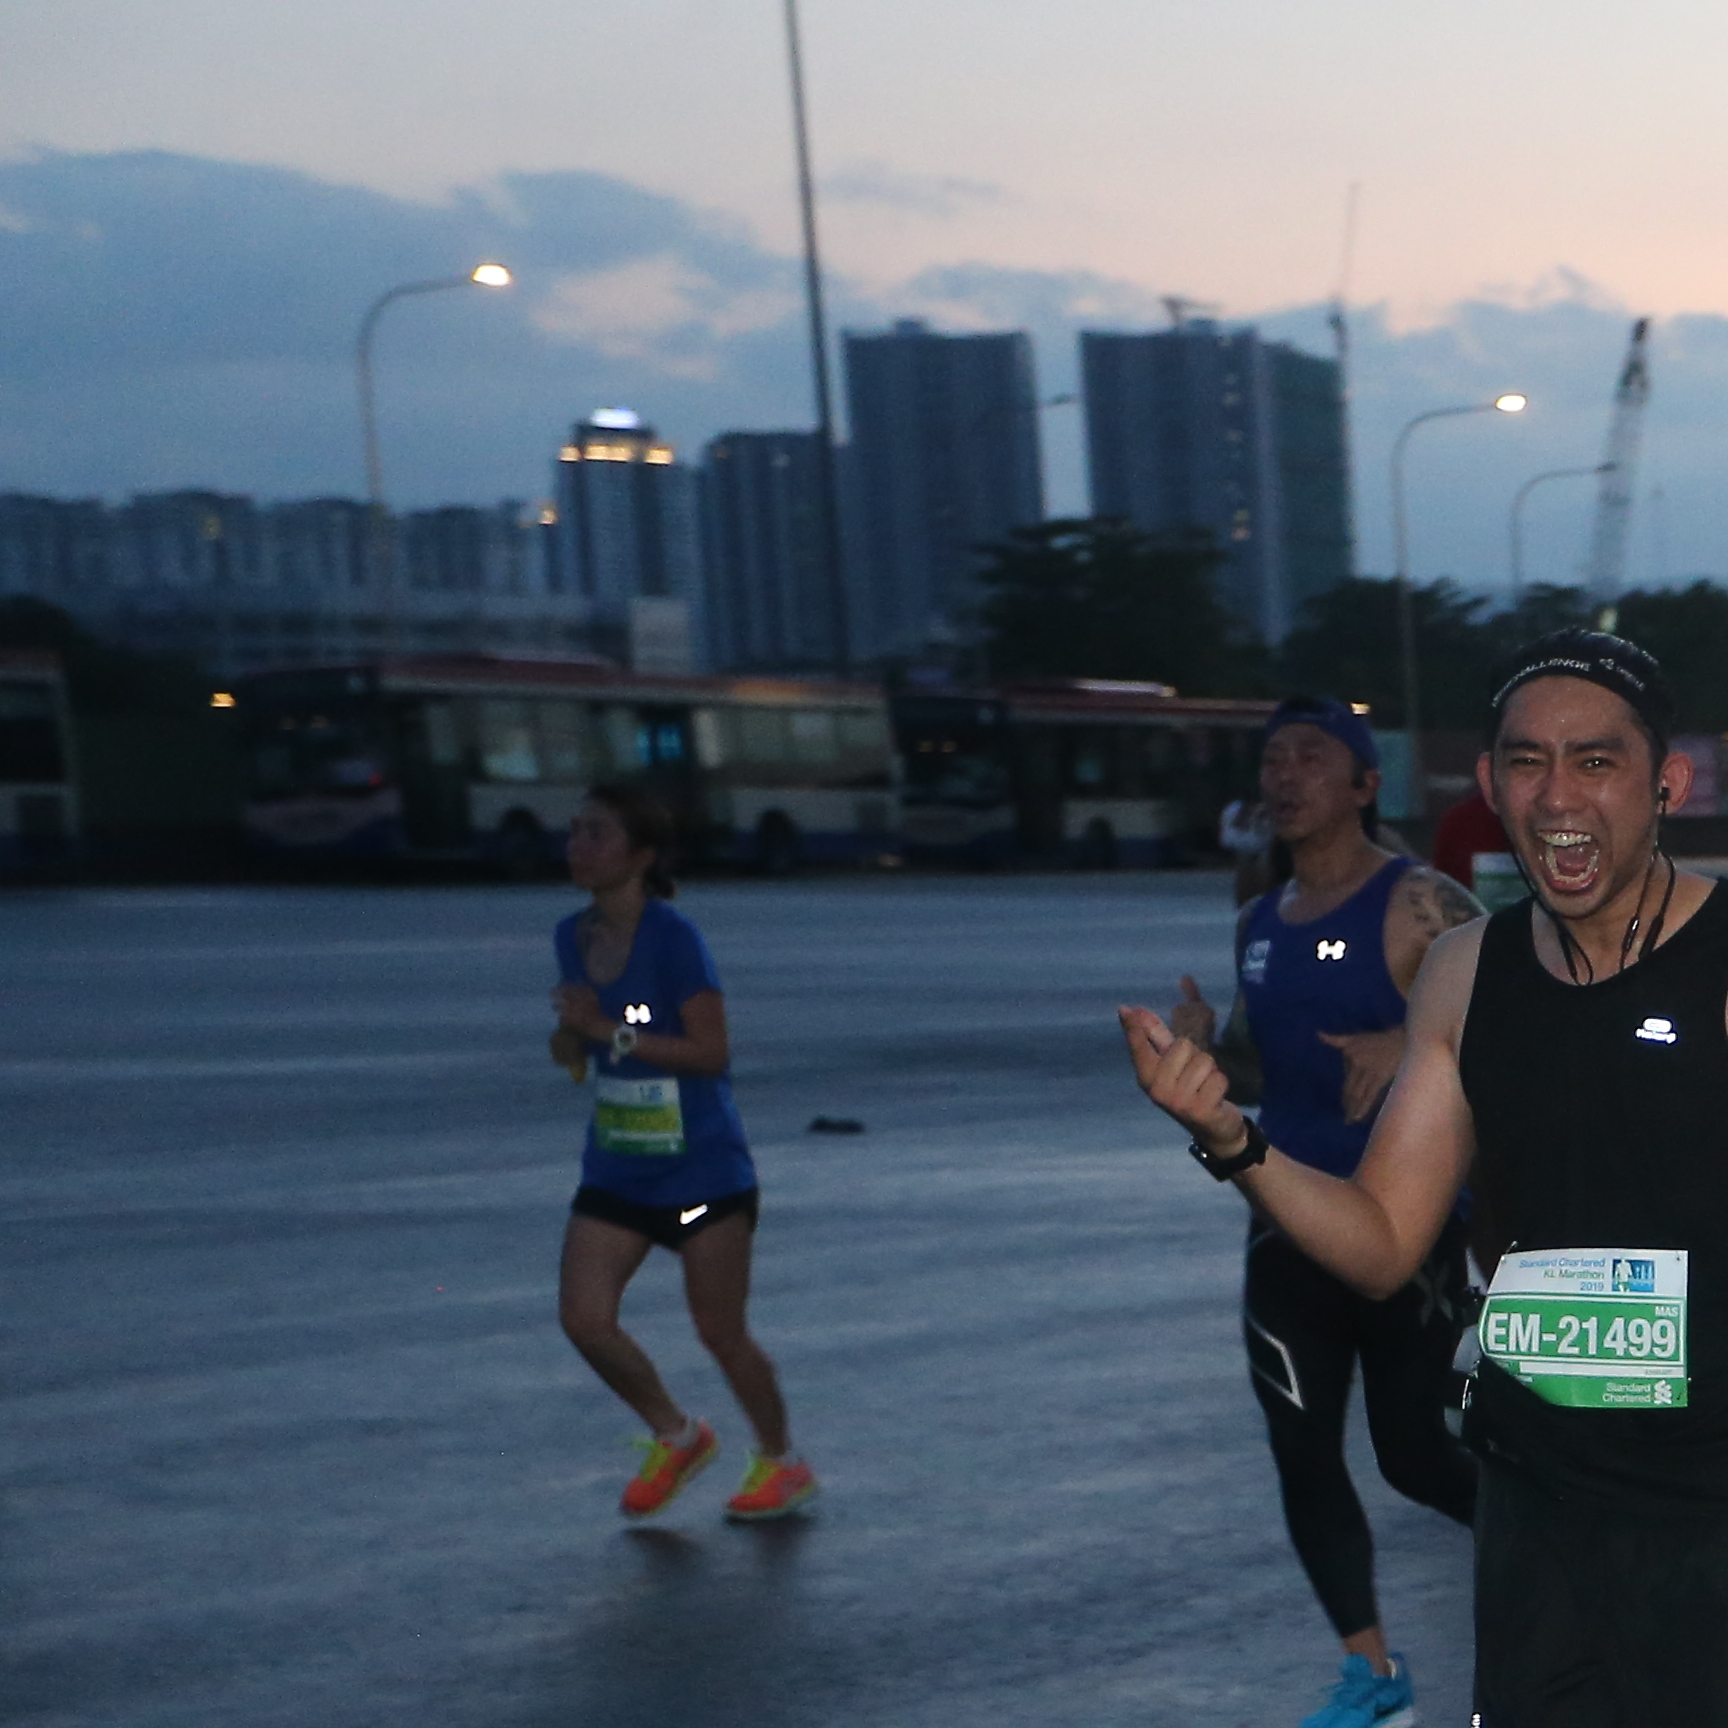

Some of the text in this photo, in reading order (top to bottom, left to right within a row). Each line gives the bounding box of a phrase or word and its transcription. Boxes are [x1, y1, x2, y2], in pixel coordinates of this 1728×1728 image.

[1543, 1269, 1605, 1280] KL Marathon
[1579, 1281, 1605, 1292] 2019
[1655, 1306, 1679, 1317] MAS
[1486, 1312, 1678, 1358] EM-21499
[1606, 1382, 1651, 1393] Standard
[1603, 1392, 1651, 1404] Chartered
